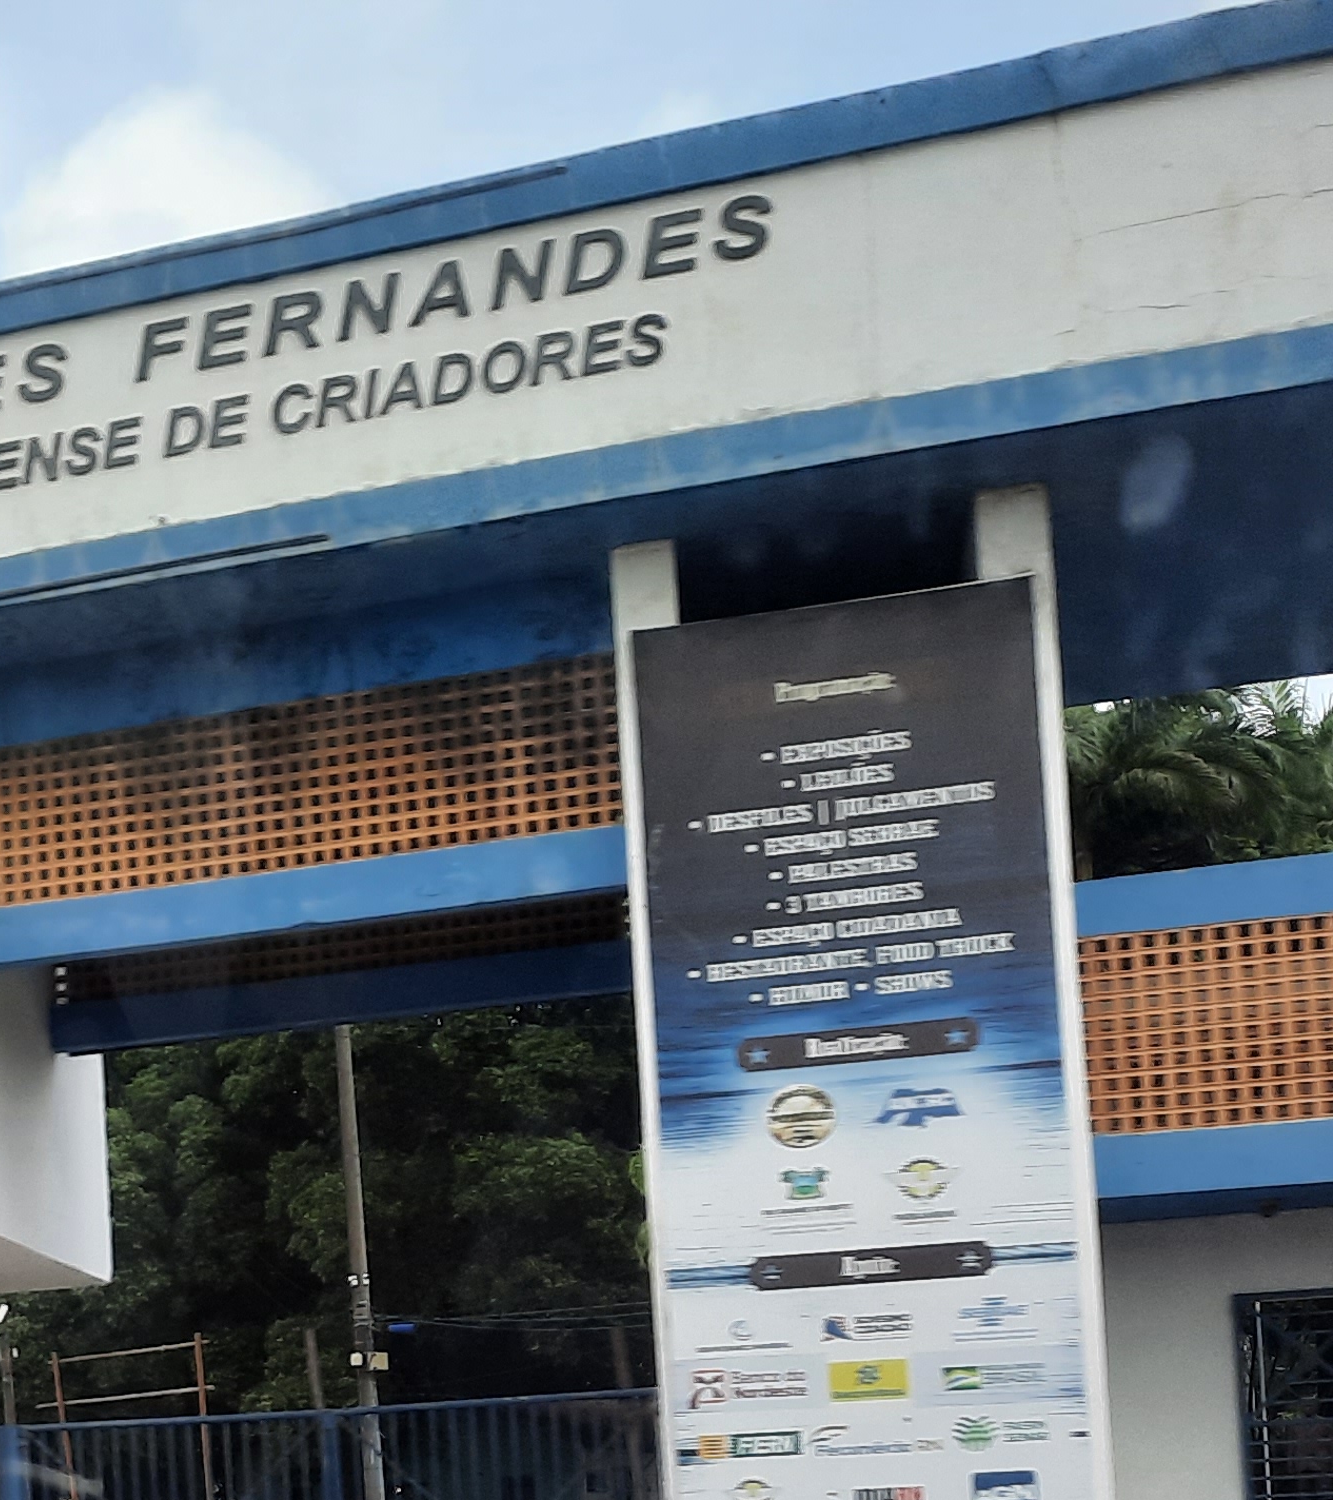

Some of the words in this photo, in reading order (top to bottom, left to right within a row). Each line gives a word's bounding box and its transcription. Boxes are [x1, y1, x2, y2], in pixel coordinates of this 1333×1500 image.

[135, 194, 774, 383] FERNANDES
[163, 393, 252, 458] DE
[271, 312, 670, 436] CRIADORES
